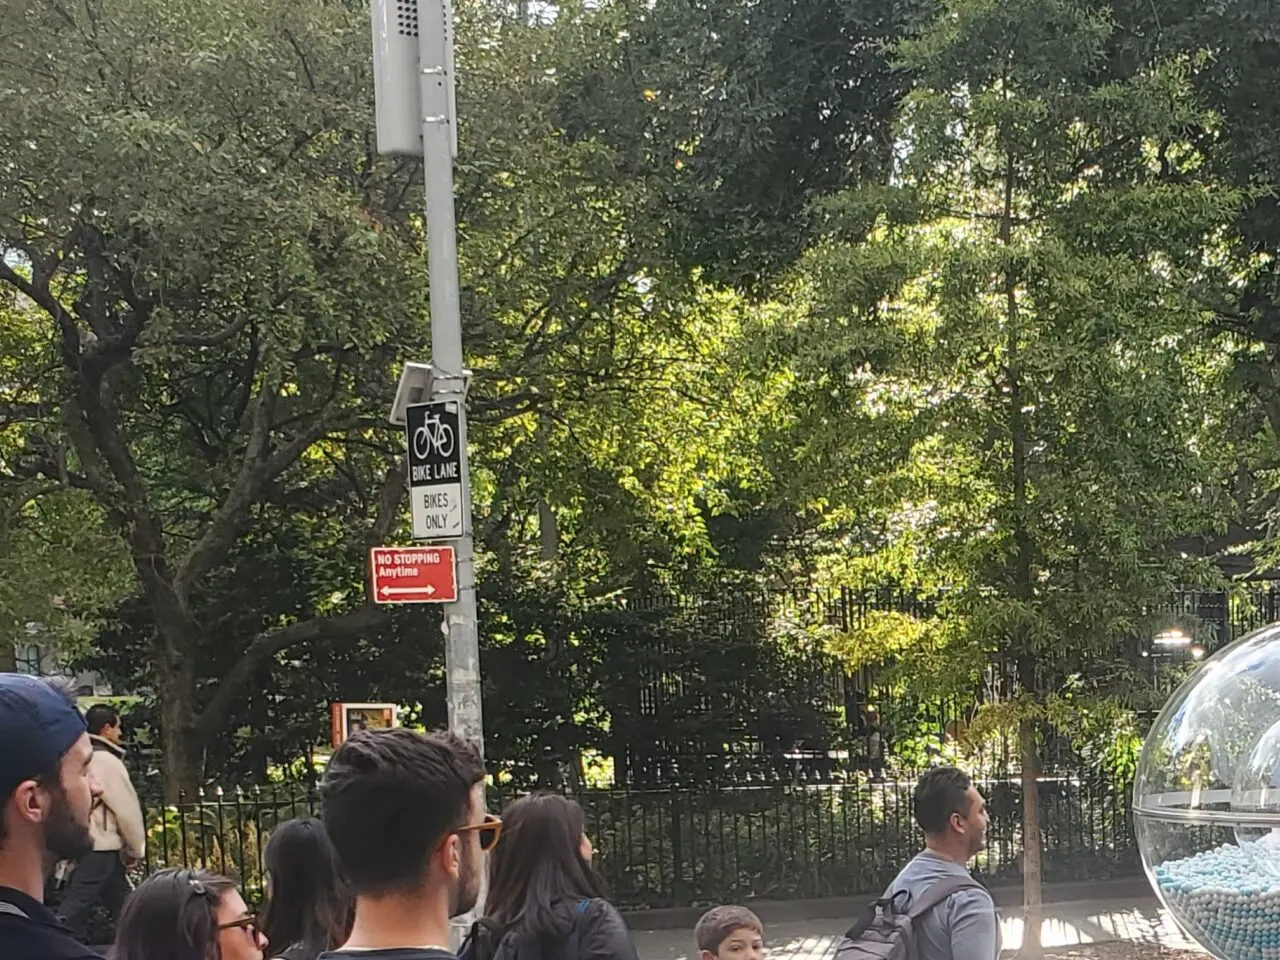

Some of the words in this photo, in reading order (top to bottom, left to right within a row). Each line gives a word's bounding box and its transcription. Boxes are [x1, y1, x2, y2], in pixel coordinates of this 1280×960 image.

[412, 465, 432, 481] BIKE
[434, 462, 458, 479] LANE
[424, 492, 448, 509] BIKES
[426, 513, 448, 530] ONLY
[377, 553, 392, 565] NO
[394, 552, 440, 564] STOPPING
[379, 566, 419, 579] Anytime
